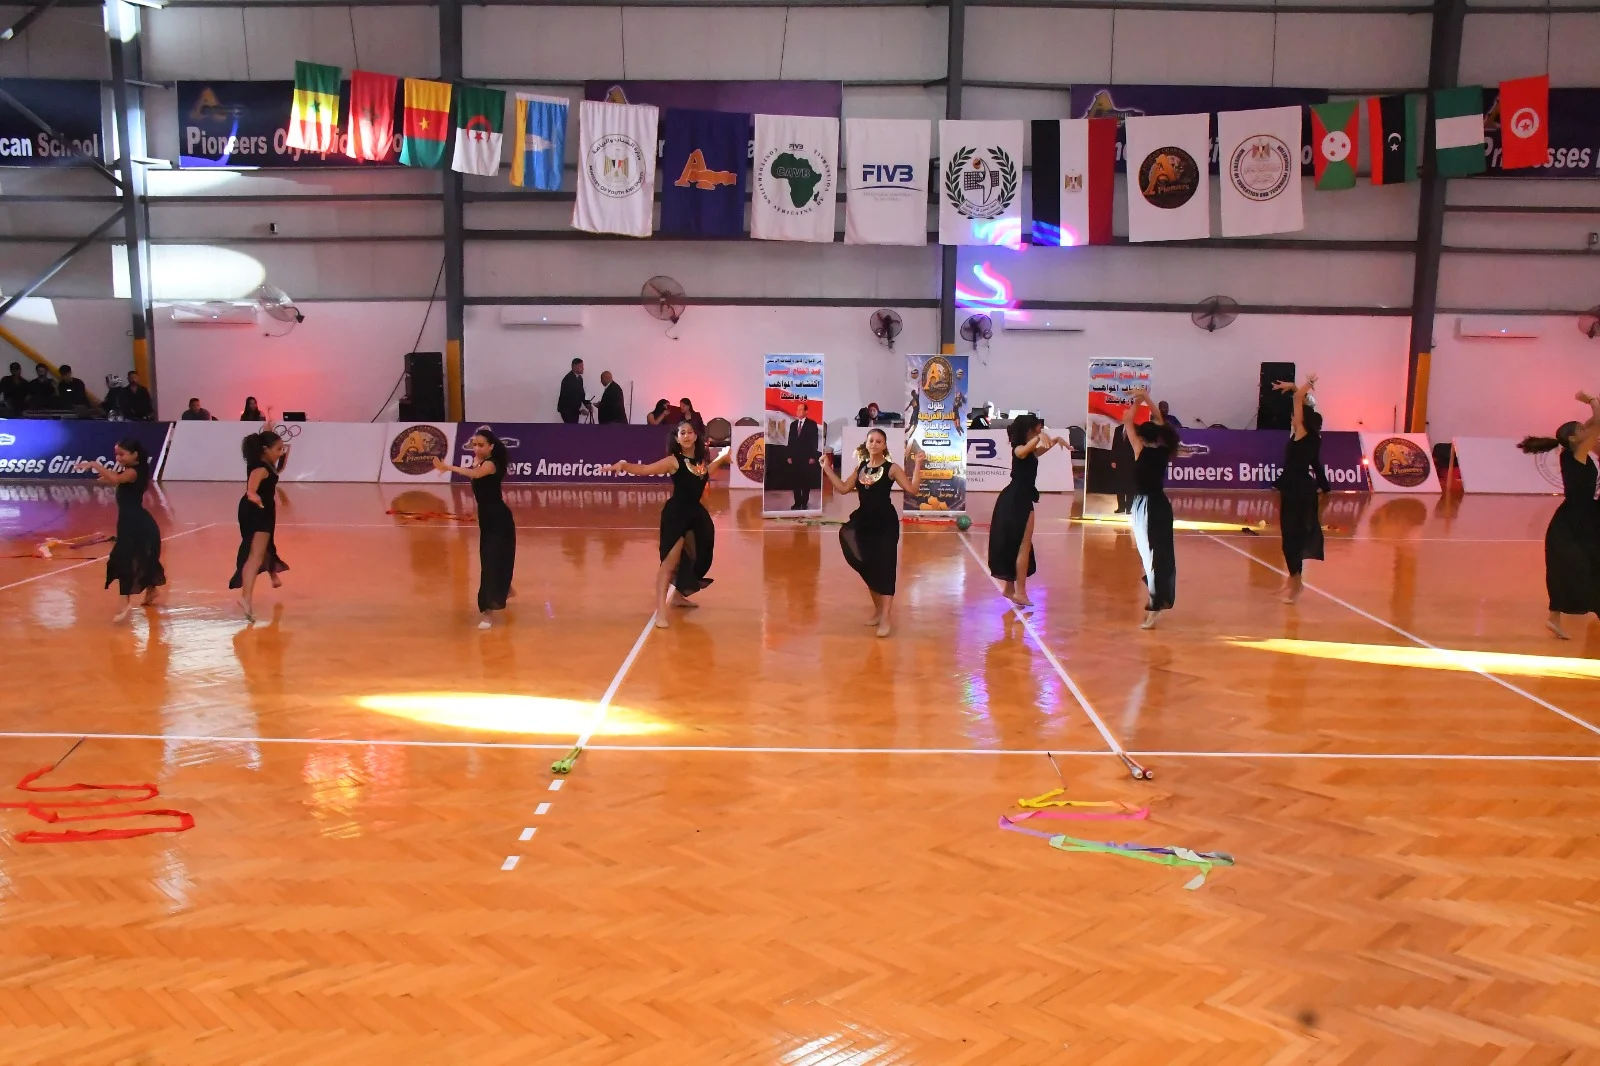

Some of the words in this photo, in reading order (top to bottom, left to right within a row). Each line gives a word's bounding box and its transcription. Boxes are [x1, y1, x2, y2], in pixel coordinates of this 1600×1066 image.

[0, 138, 33, 157] can
[186, 126, 268, 155] Pioneers
[589, 165, 600, 187] MINISTRY
[776, 166, 811, 178] CAVB
[862, 164, 914, 182] FIVB
[768, 380, 794, 389] المواهب
[795, 379, 820, 388] اكتشاف
[1092, 383, 1119, 393] المواهب
[536, 458, 611, 476] American
[1166, 462, 1234, 481] ioneers
[1239, 463, 1286, 482] Britis
[1393, 467, 1423, 475] Pioneers
